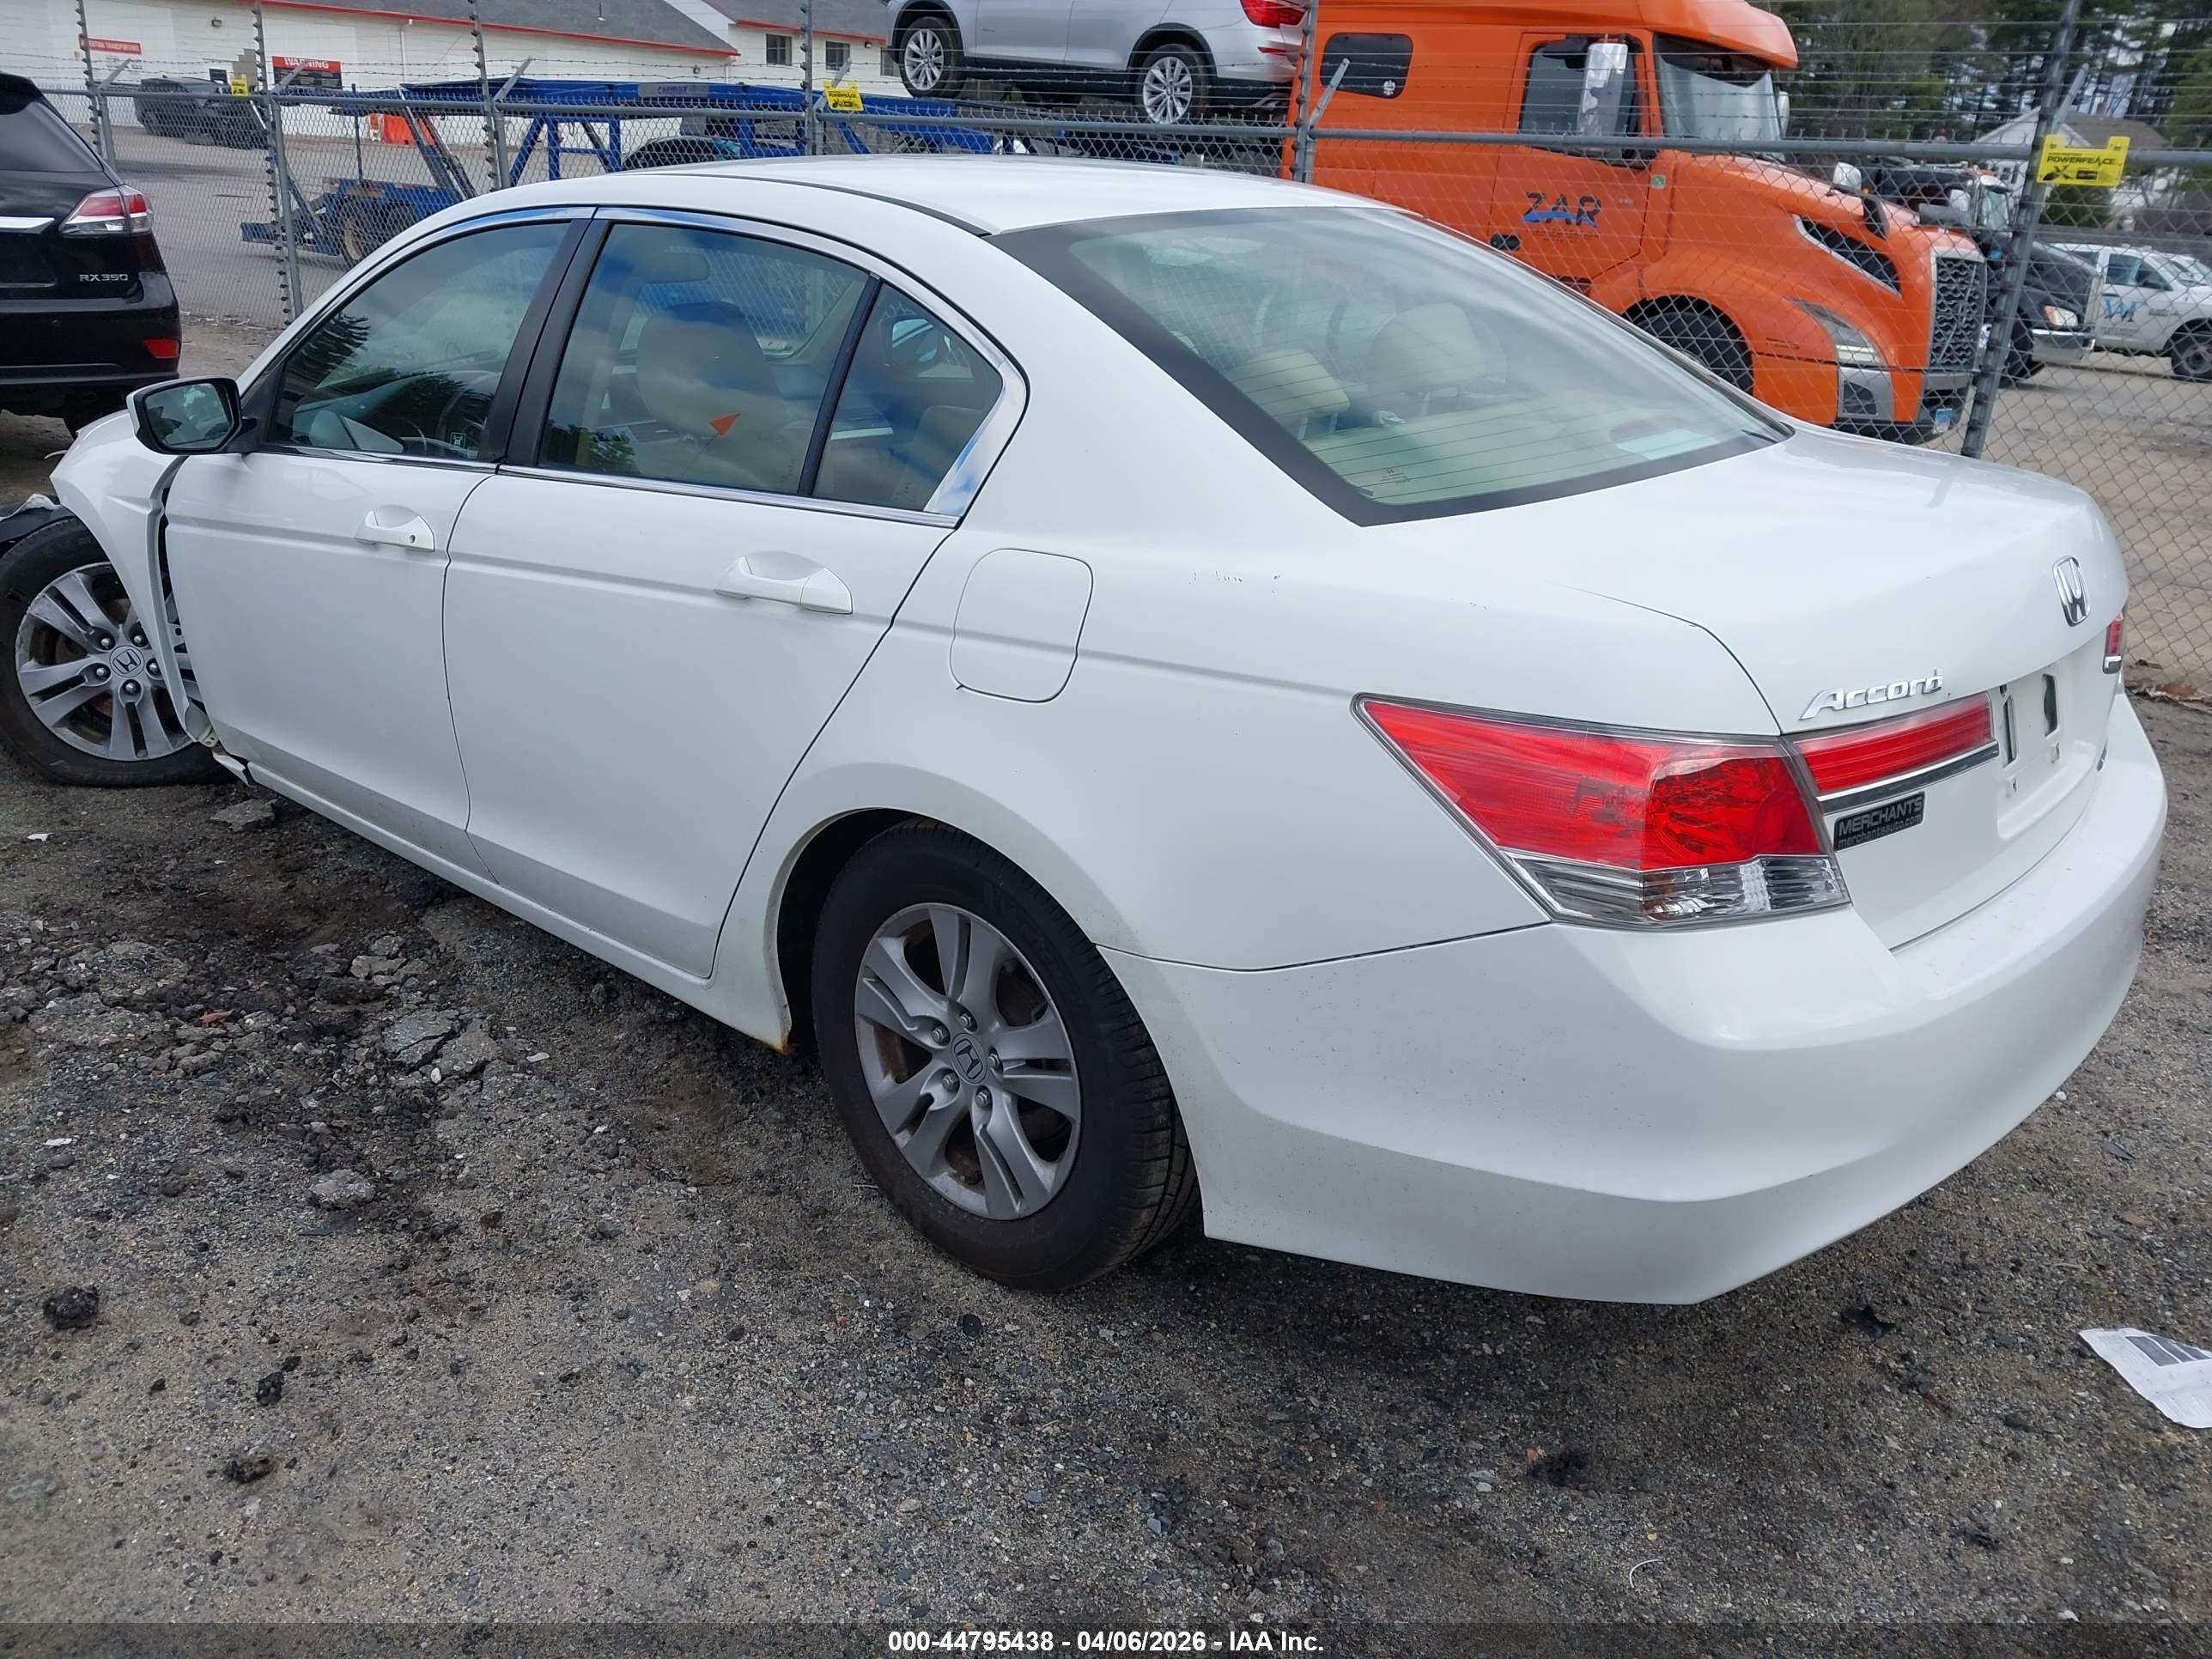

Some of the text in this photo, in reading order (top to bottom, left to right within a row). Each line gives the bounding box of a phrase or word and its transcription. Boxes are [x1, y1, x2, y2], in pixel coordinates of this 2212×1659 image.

[1522, 191, 1601, 226] ZAR
[1799, 669, 1944, 720] Accord
[1838, 796, 1923, 837] MERCHANTS
[1838, 813, 1922, 849] merchantsauto.com
